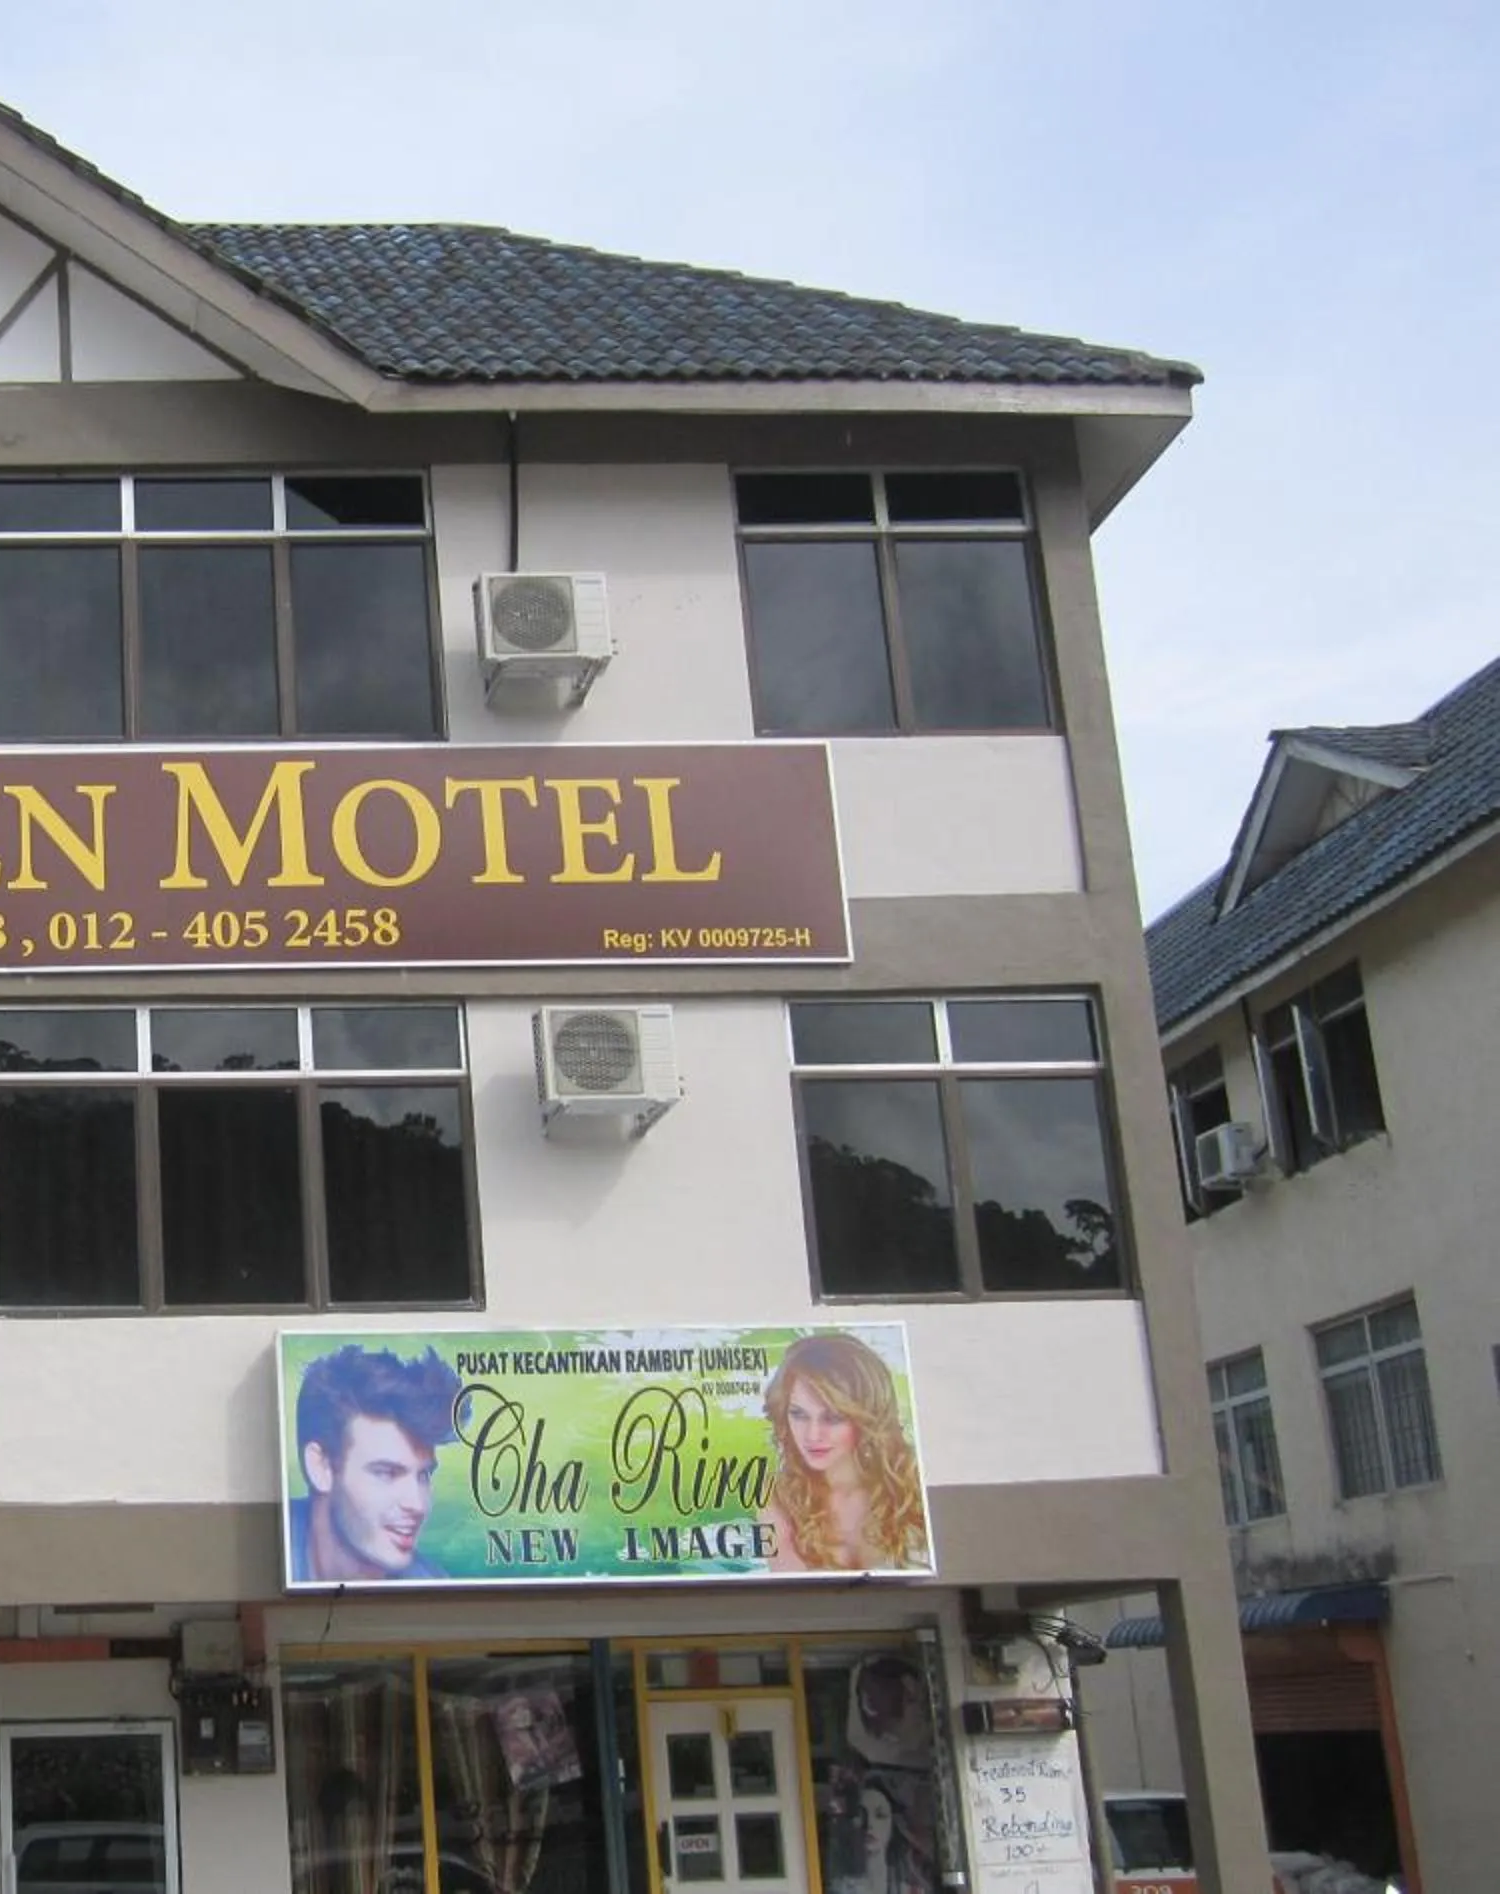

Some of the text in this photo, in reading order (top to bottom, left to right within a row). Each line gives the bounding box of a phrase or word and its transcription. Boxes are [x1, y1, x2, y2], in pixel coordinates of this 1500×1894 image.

[159, 761, 722, 890] MOTEL
[48, 911, 136, 951] 012
[181, 909, 269, 949] 405
[284, 907, 401, 947] 2458
[603, 927, 811, 953] Reg: KV 0009725-H
[457, 1346, 769, 1378] PUSAT KECANTIKAN RAMBUT (UNISEX)
[453, 1383, 776, 1518] Cha Rira
[487, 1522, 779, 1564] NEW IMAGE
